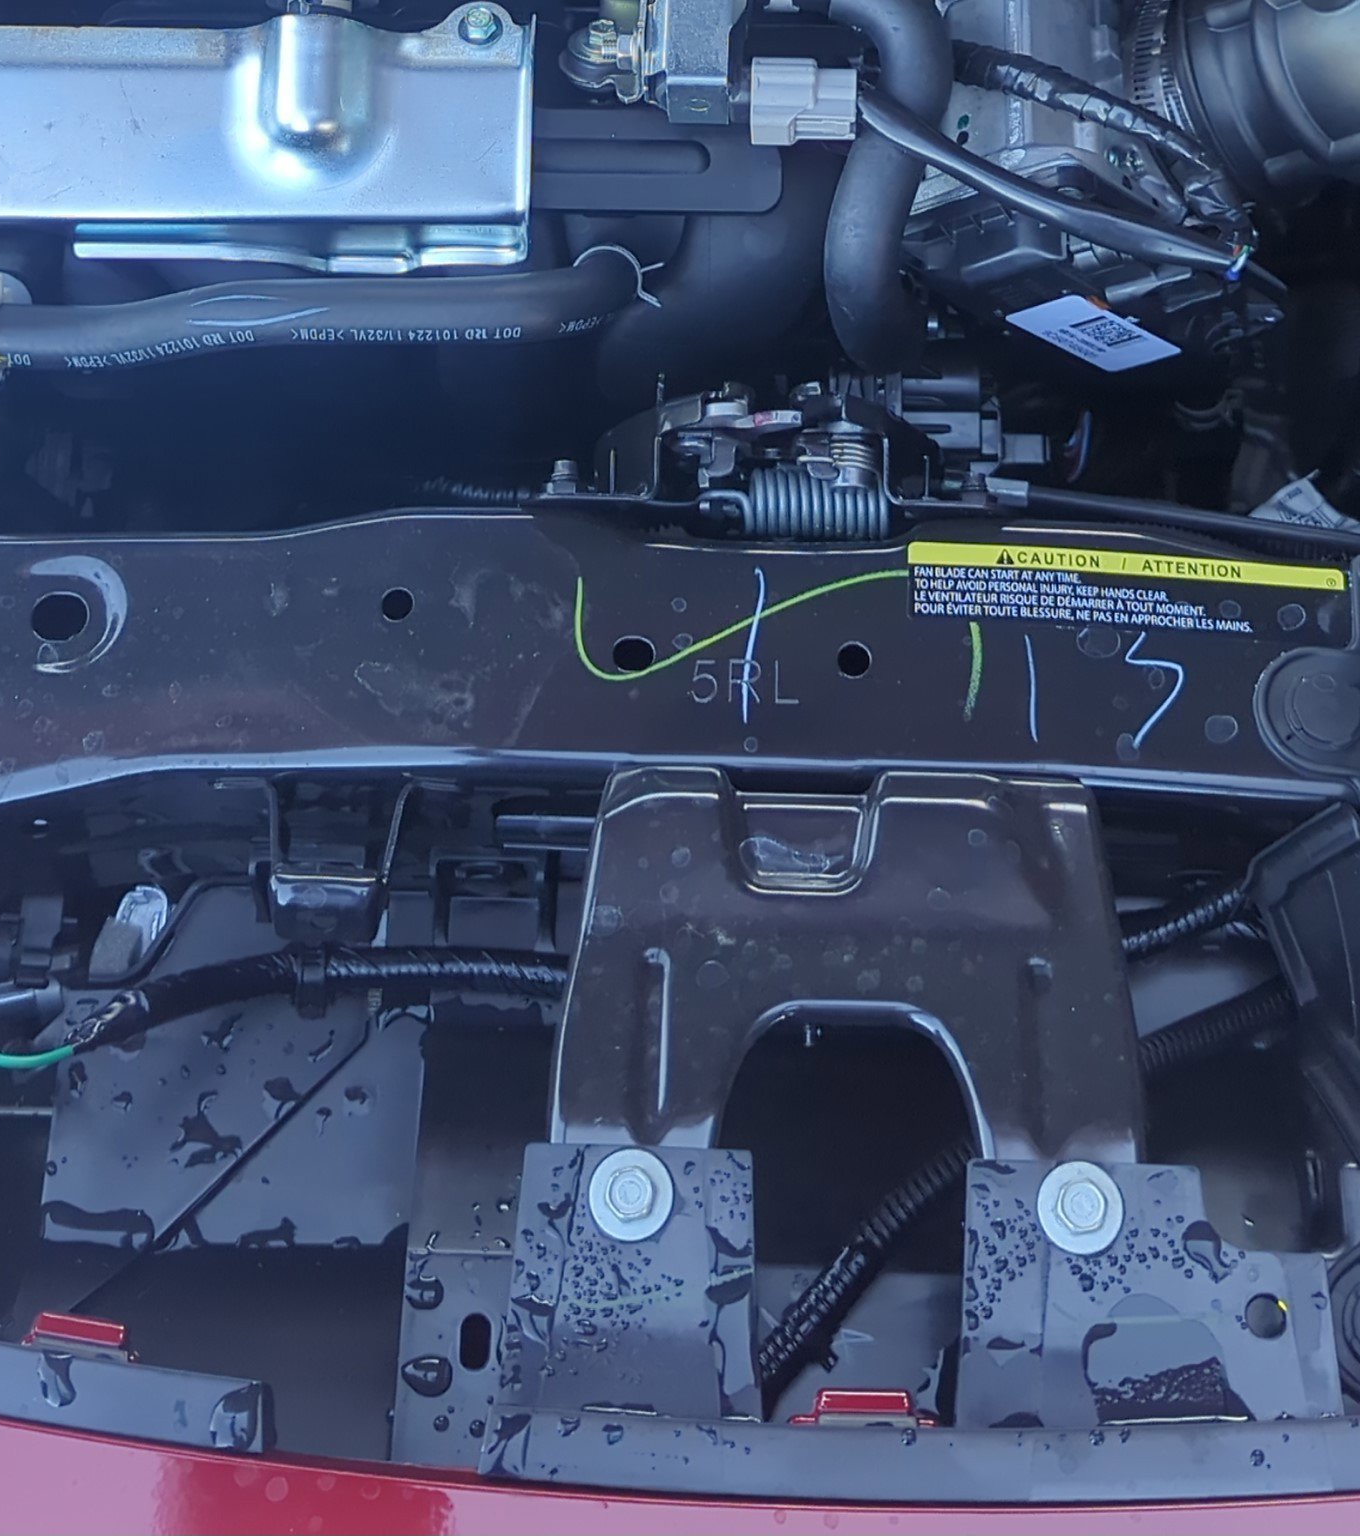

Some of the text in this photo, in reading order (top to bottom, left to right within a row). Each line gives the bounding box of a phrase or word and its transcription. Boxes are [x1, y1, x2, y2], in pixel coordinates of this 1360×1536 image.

[229, 329, 255, 343] DOT
[290, 328, 345, 341] >EPDM<
[353, 328, 402, 342] 11/32VL
[408, 328, 459, 341] 101224
[493, 327, 522, 339] DOT
[156, 338, 201, 359] 101224
[63, 353, 112, 369] >EPDM<
[1017, 552, 1100, 568] CAUTION
[1142, 559, 1242, 579] ATTENTION
[914, 566, 1082, 584] FAN BLADE CAN START AT ANY TIME.
[915, 578, 1169, 602] TO HELP AVOID PERSONAL INJURY, KEEP HANDS CLEAR.
[914, 590, 1207, 617] LE VENTILATEUR RISQUE DE DÉMARRER À TOUT MOMENT.
[914, 602, 1254, 633] POUR ÉVITER TOUTE BLESSURE, NE PAS EN APPROCHER LES MAINS.
